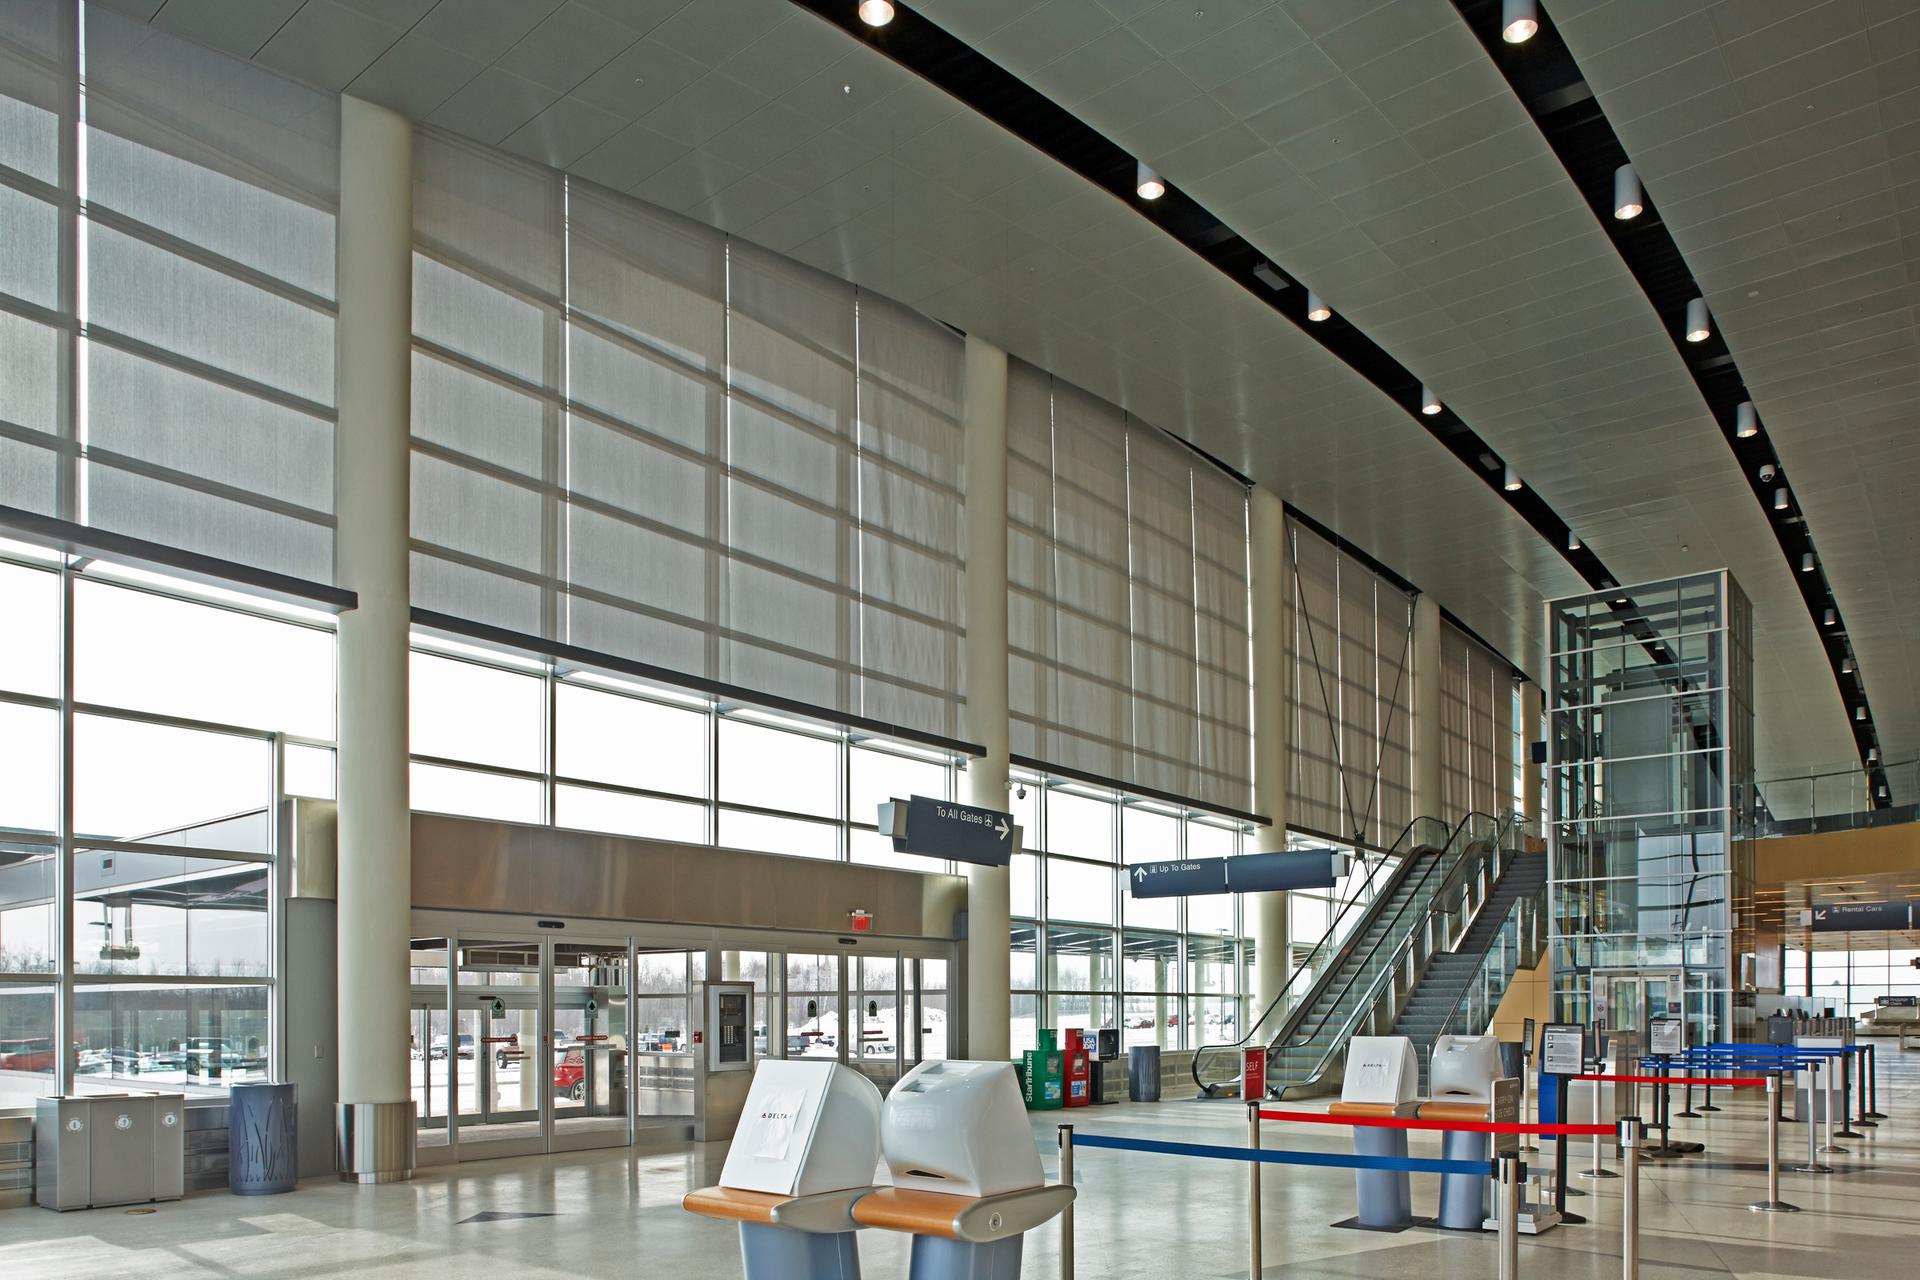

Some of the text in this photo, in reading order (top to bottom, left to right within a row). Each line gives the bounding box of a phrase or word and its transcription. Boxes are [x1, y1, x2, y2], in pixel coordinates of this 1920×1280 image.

[936, 805, 983, 824] To All Gates
[1159, 863, 1201, 874] Up To Gates
[1246, 1061, 1258, 1071] SELF
[1025, 1051, 1033, 1103] StarTribune
